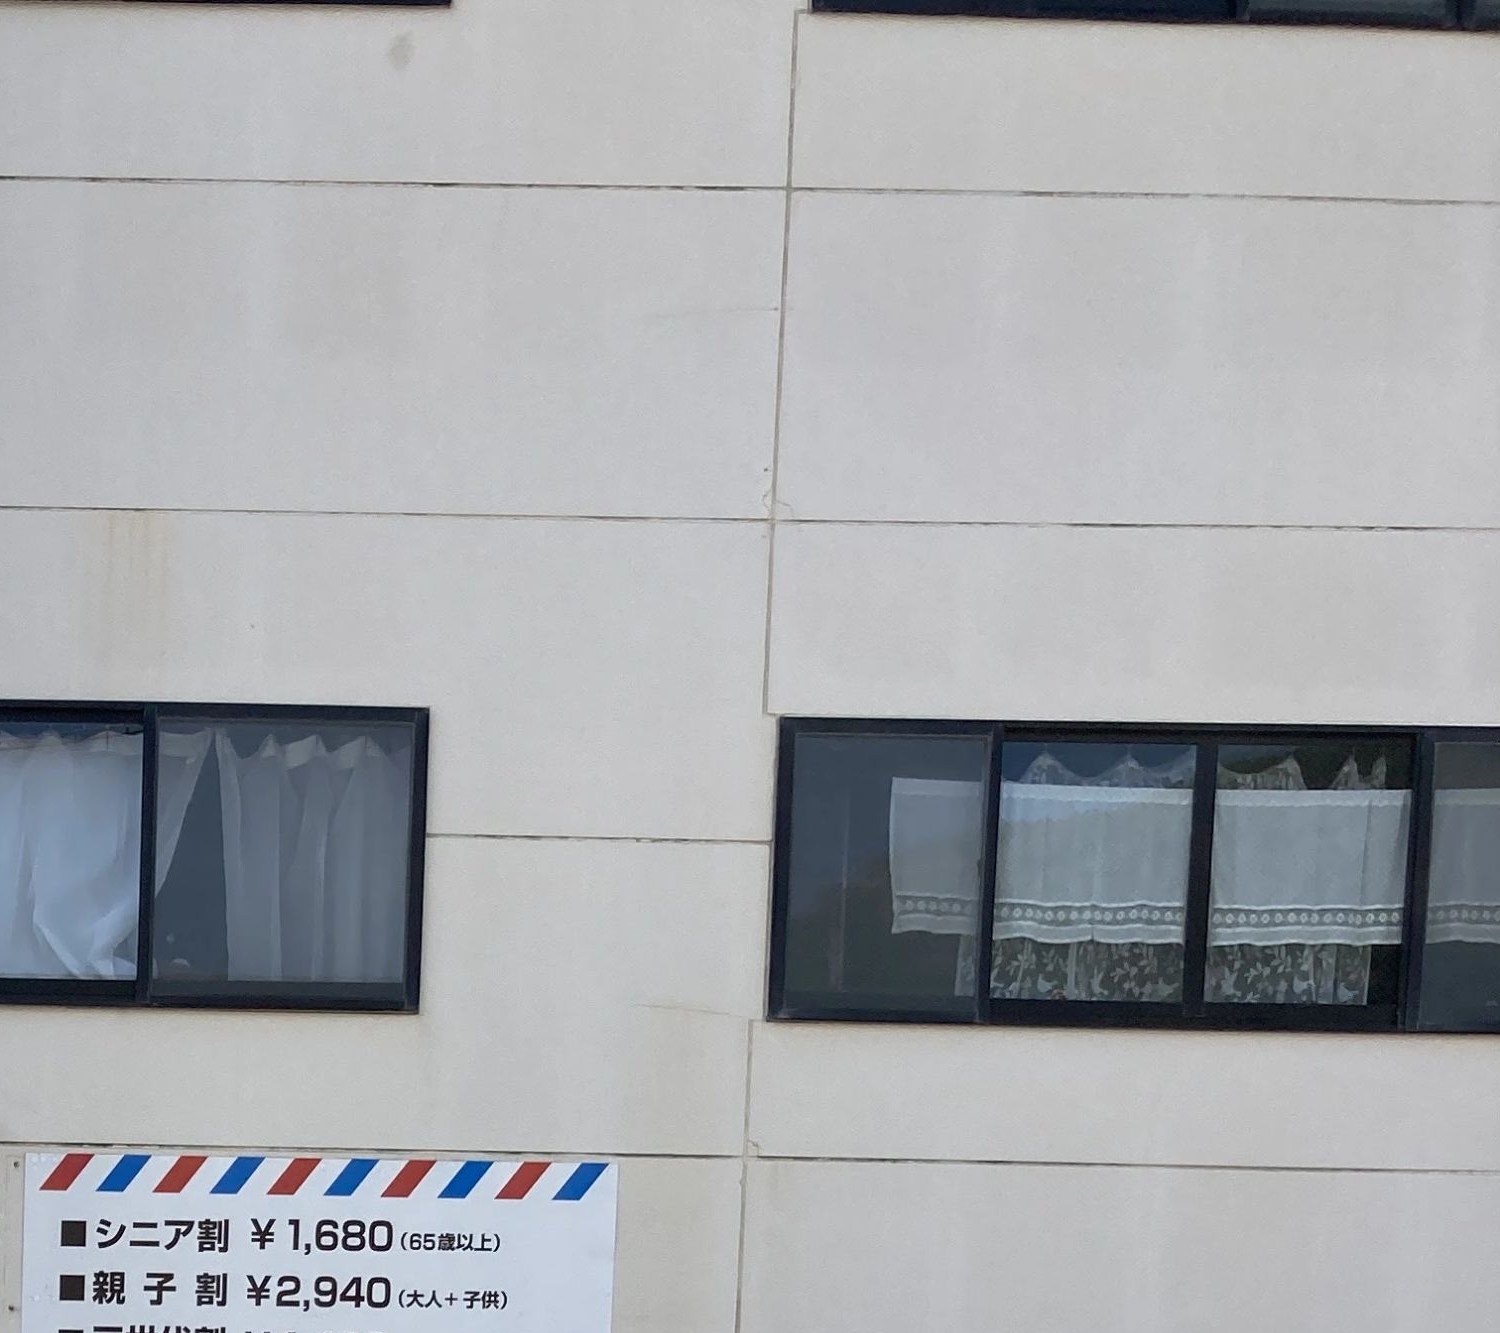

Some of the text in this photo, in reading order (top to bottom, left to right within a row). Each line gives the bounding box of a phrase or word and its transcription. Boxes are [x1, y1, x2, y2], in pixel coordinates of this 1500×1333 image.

[94, 1218, 229, 1253] シニア割
[250, 1217, 393, 1256] ¥1,680
[92, 1271, 228, 1307] 親子割
[246, 1274, 392, 1312] ¥2,940
